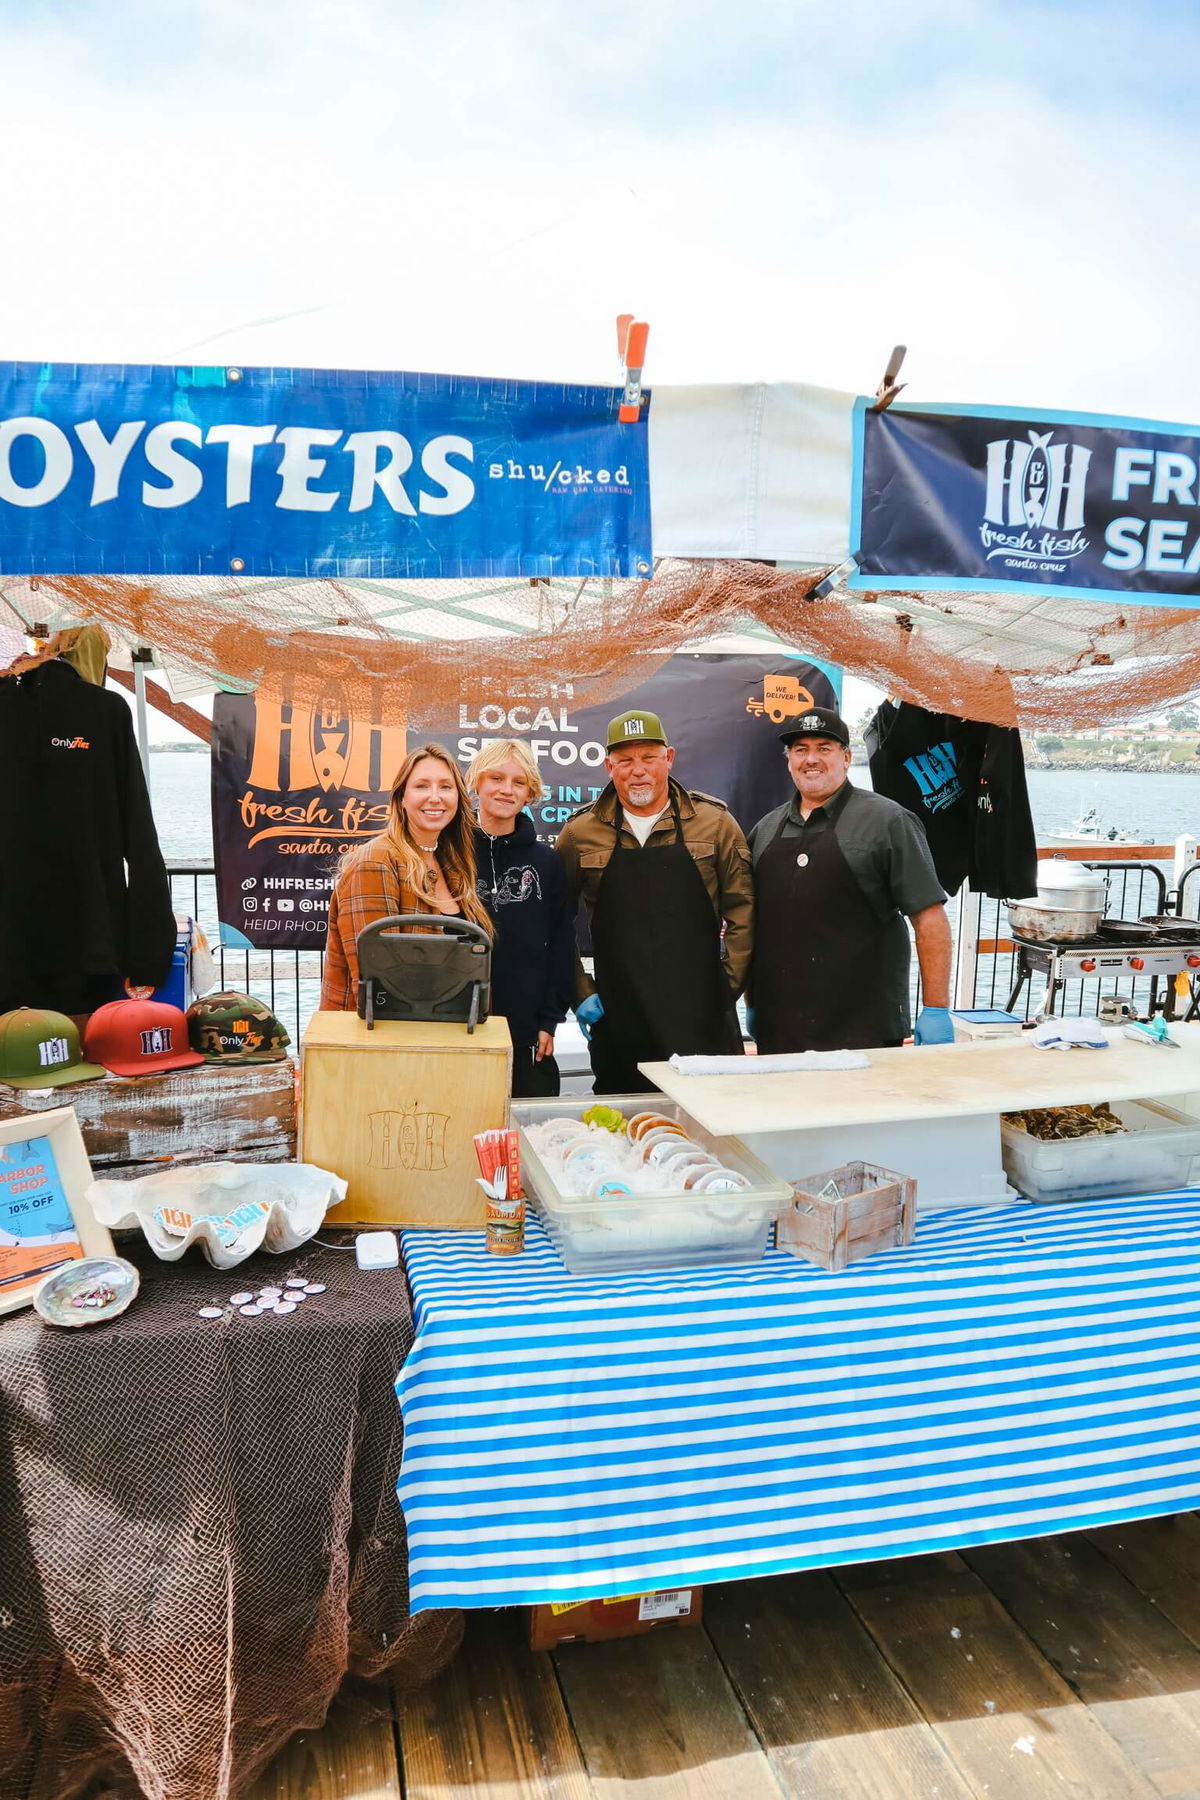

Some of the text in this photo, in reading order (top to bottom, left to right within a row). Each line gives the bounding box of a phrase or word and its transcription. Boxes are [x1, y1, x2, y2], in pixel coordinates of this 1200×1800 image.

[0, 416, 475, 516] OYSTERS
[1112, 447, 1200, 506] FR
[979, 523, 1090, 557] fresh fish
[1004, 558, 1066, 572] santa cruz
[766, 692, 796, 700] DELIVER!
[459, 703, 579, 733] LOCAL
[558, 786, 581, 802] IN
[238, 791, 334, 828] fresh
[541, 806, 574, 822] CR
[278, 838, 333, 855] santa
[244, 919, 281, 931] HEIDI
[376, 991, 387, 1005] 5
[11, 1176, 48, 1194] SHOP
[9, 1203, 29, 1214] 10%
[32, 1195, 54, 1208] OFF
